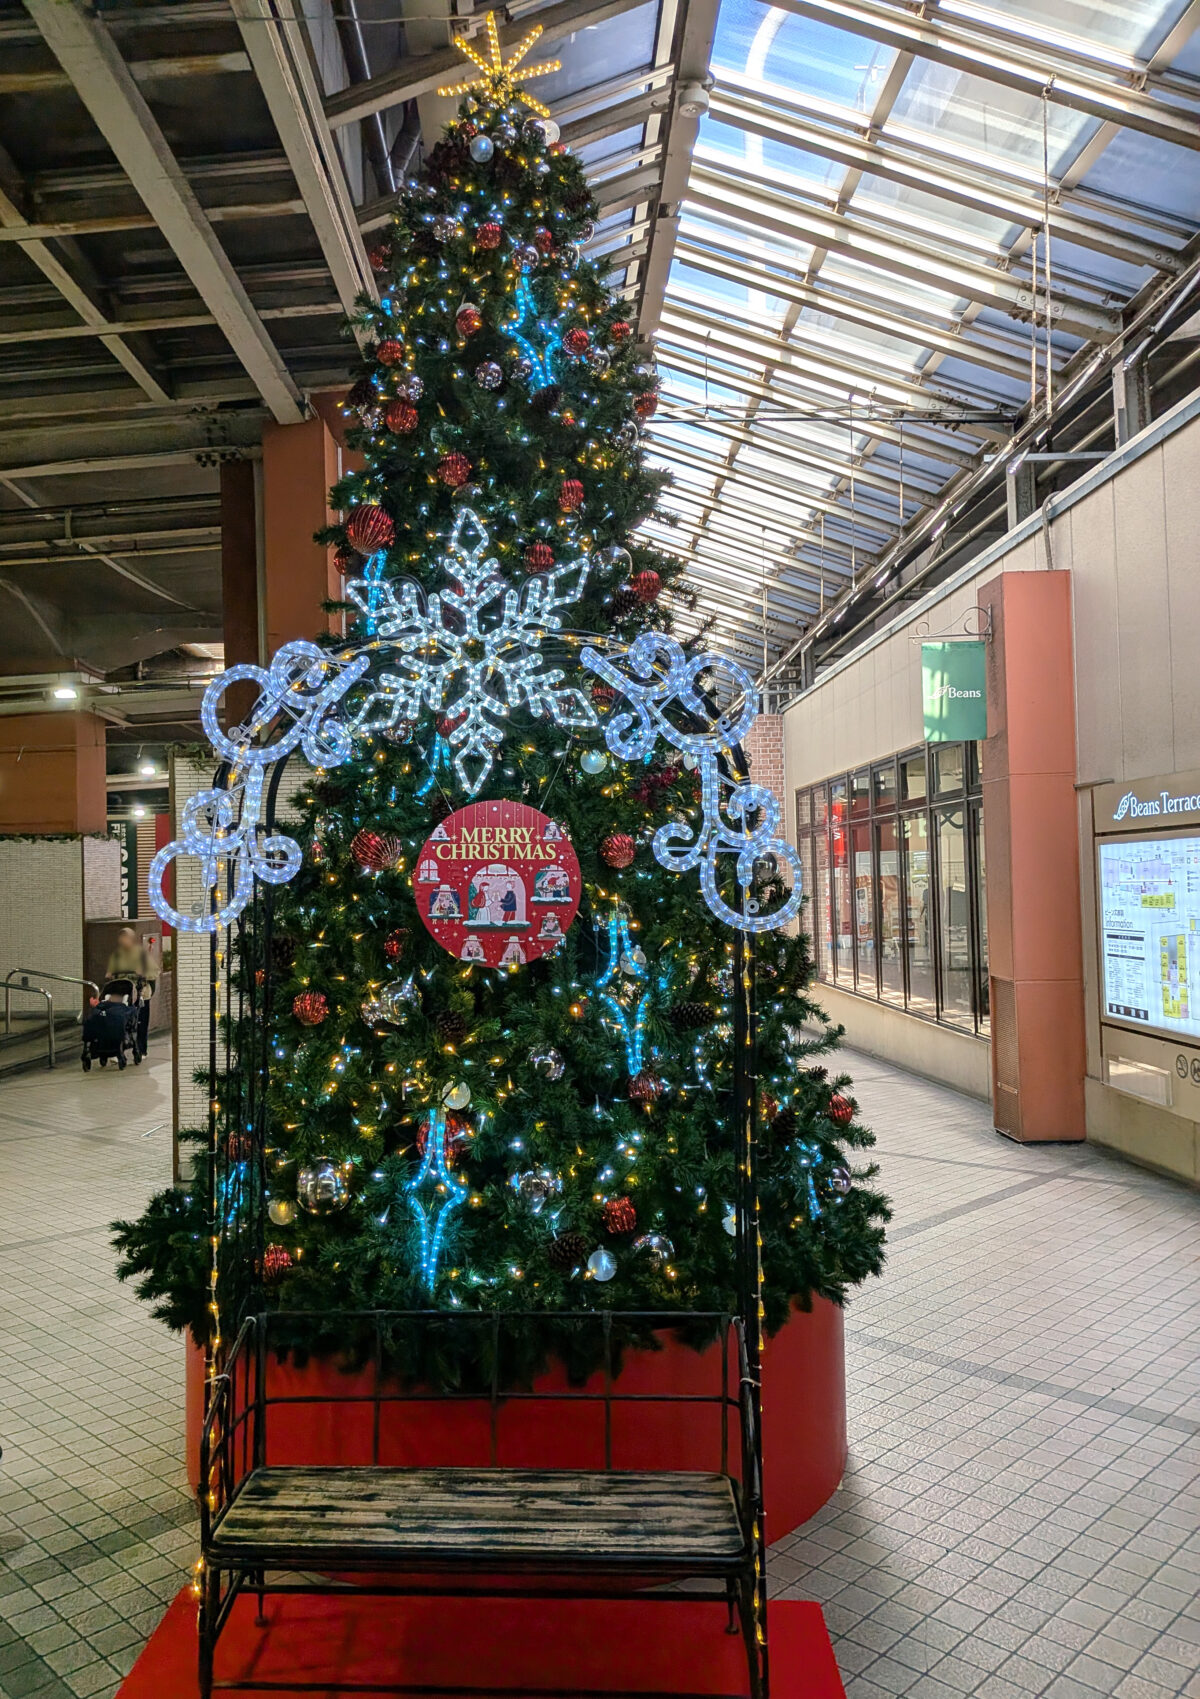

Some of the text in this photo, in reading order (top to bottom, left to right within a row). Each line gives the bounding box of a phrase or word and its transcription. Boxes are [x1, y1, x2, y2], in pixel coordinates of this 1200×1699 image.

[948, 687, 982, 699] Beans
[1130, 791, 1200, 818] Beans Terrace
[460, 827, 535, 844] MERRY
[436, 843, 557, 860] CHRISTMAS
